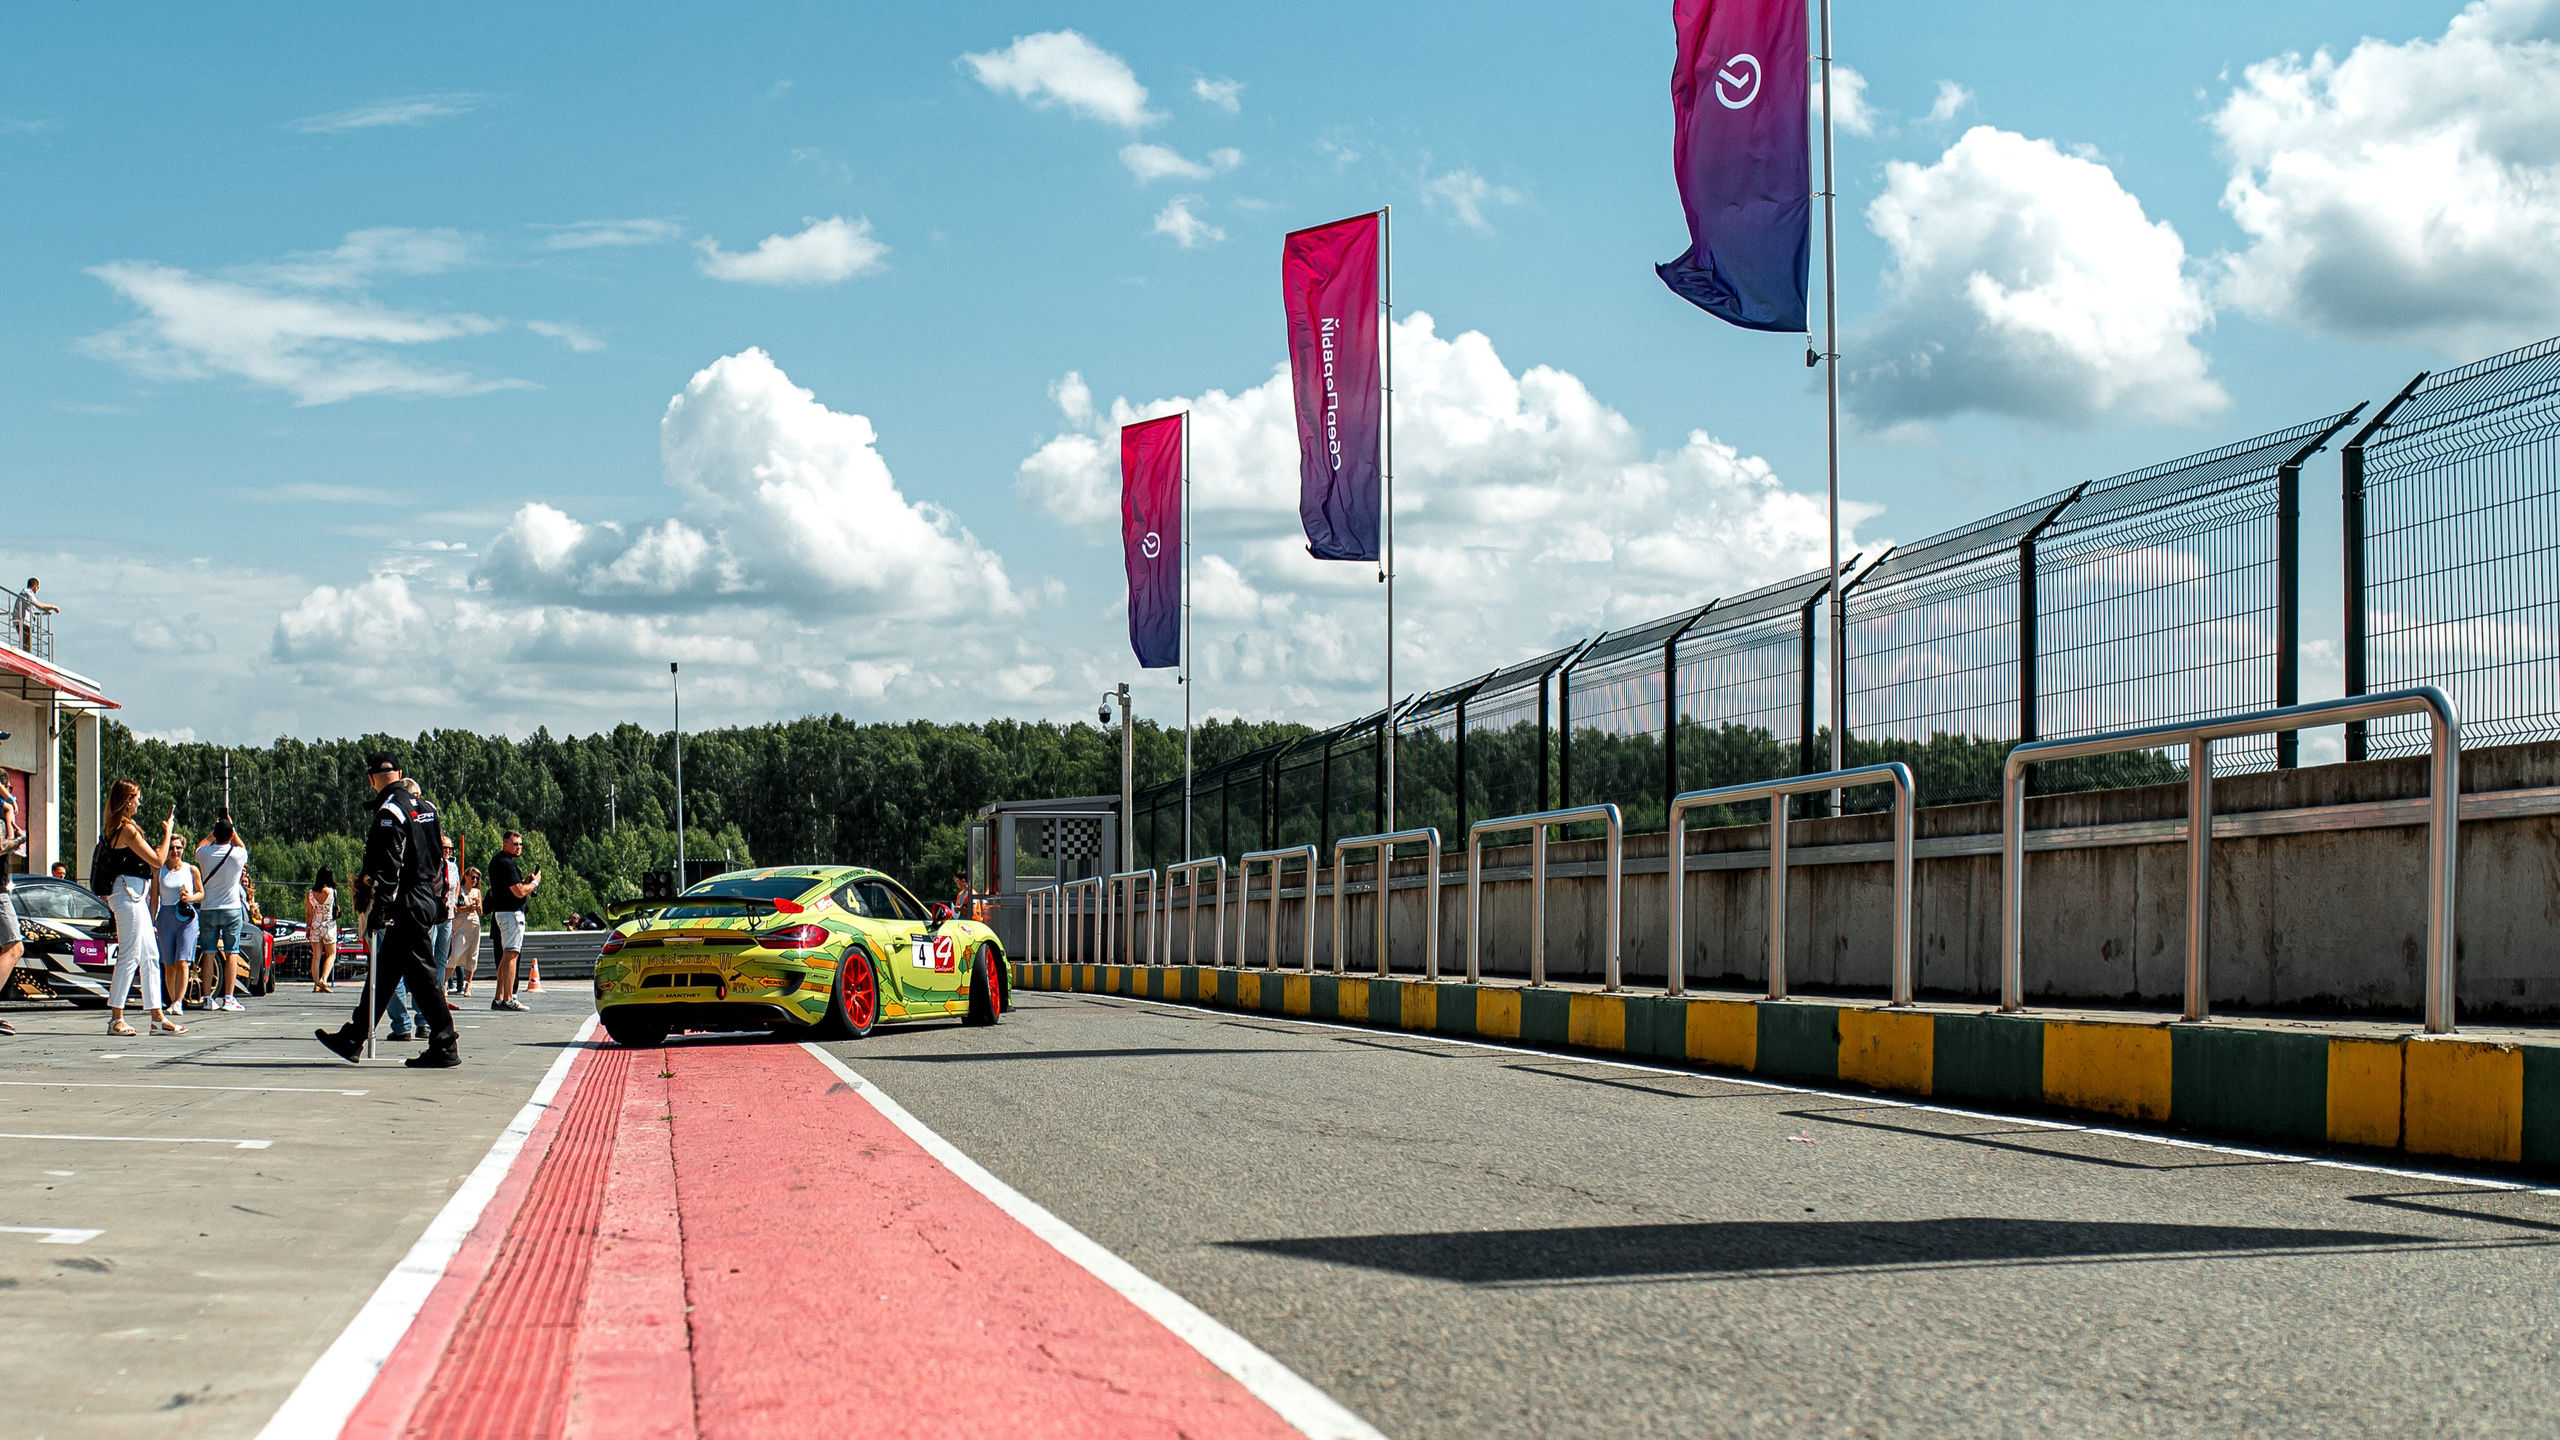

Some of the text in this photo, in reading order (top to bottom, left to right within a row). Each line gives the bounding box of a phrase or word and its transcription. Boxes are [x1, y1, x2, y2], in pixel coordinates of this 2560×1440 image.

[780, 904, 799, 912] GT4
[847, 888, 861, 914] 4
[275, 927, 287, 936] 12
[647, 953, 712, 966] MONSTER
[919, 944, 926, 966] 4
[936, 936, 952, 966] 4
